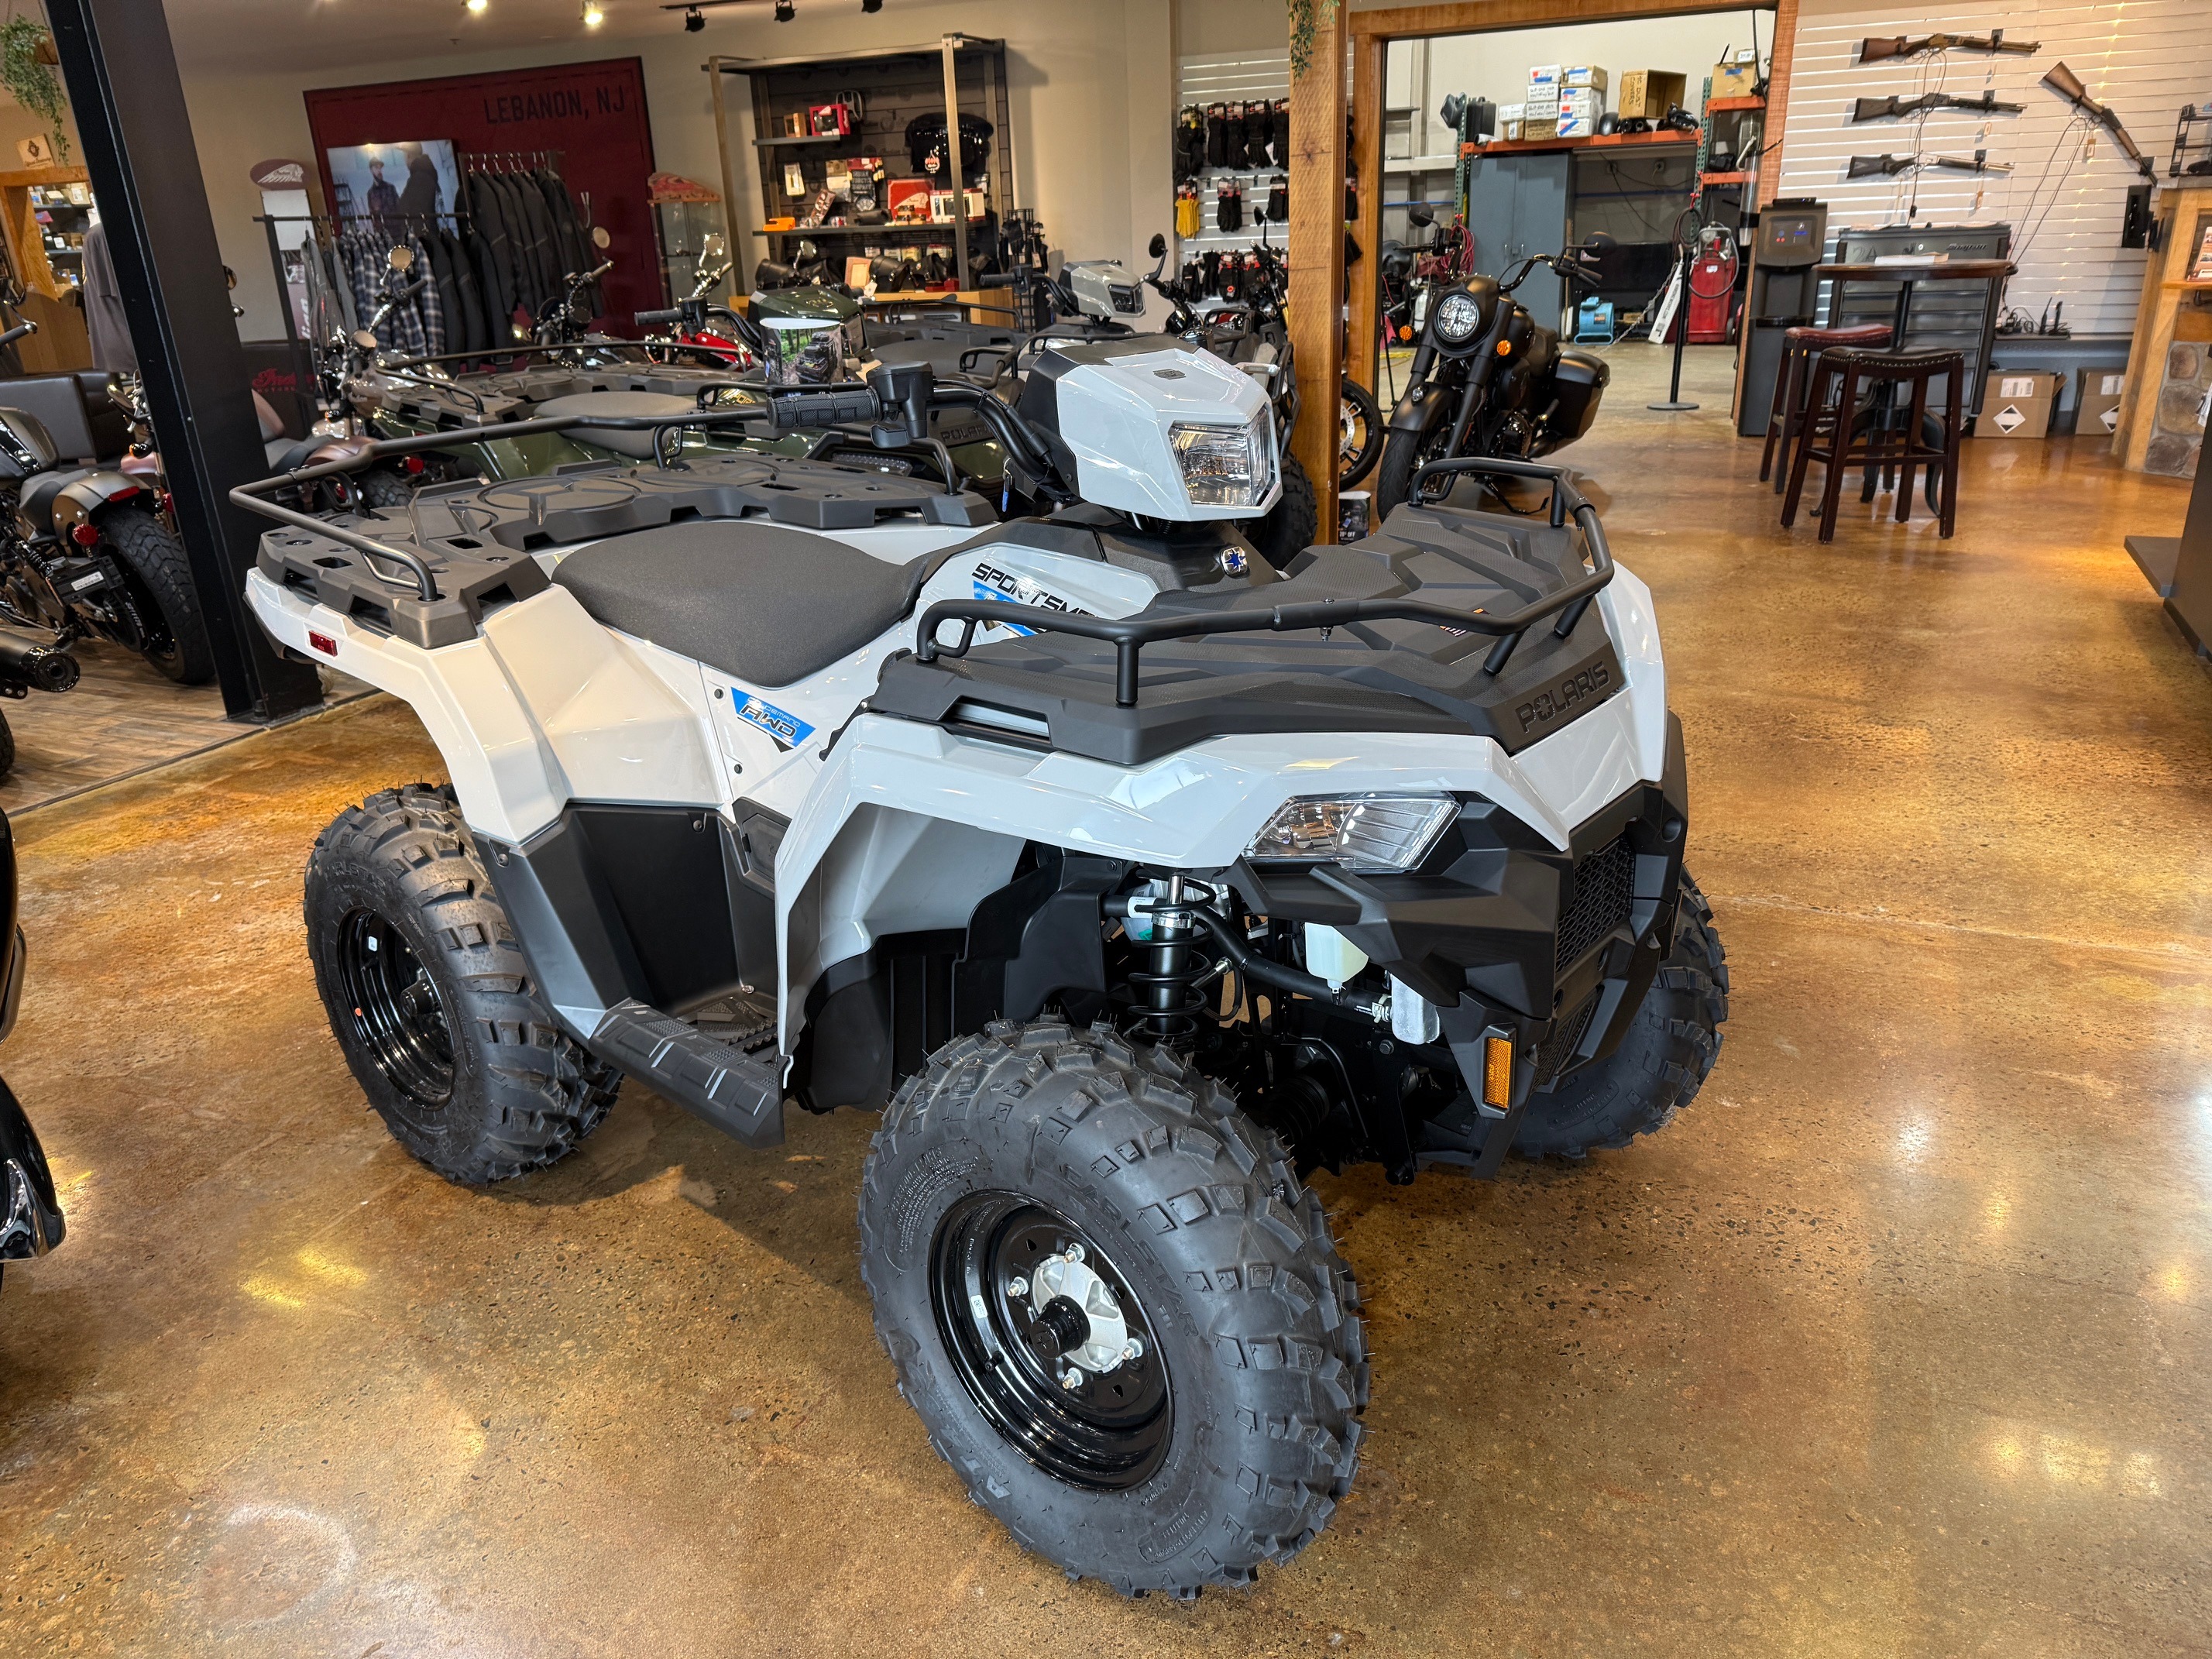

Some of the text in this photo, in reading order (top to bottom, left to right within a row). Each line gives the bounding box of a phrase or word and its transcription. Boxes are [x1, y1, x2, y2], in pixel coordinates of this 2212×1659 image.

[483, 84, 625, 125] LEBANON, NJ
[764, 705, 801, 727] DEMAND
[1515, 661, 1610, 734] POLARIS
[740, 704, 797, 738] AWD
[1058, 1162, 1200, 1338] CARLSTAR
